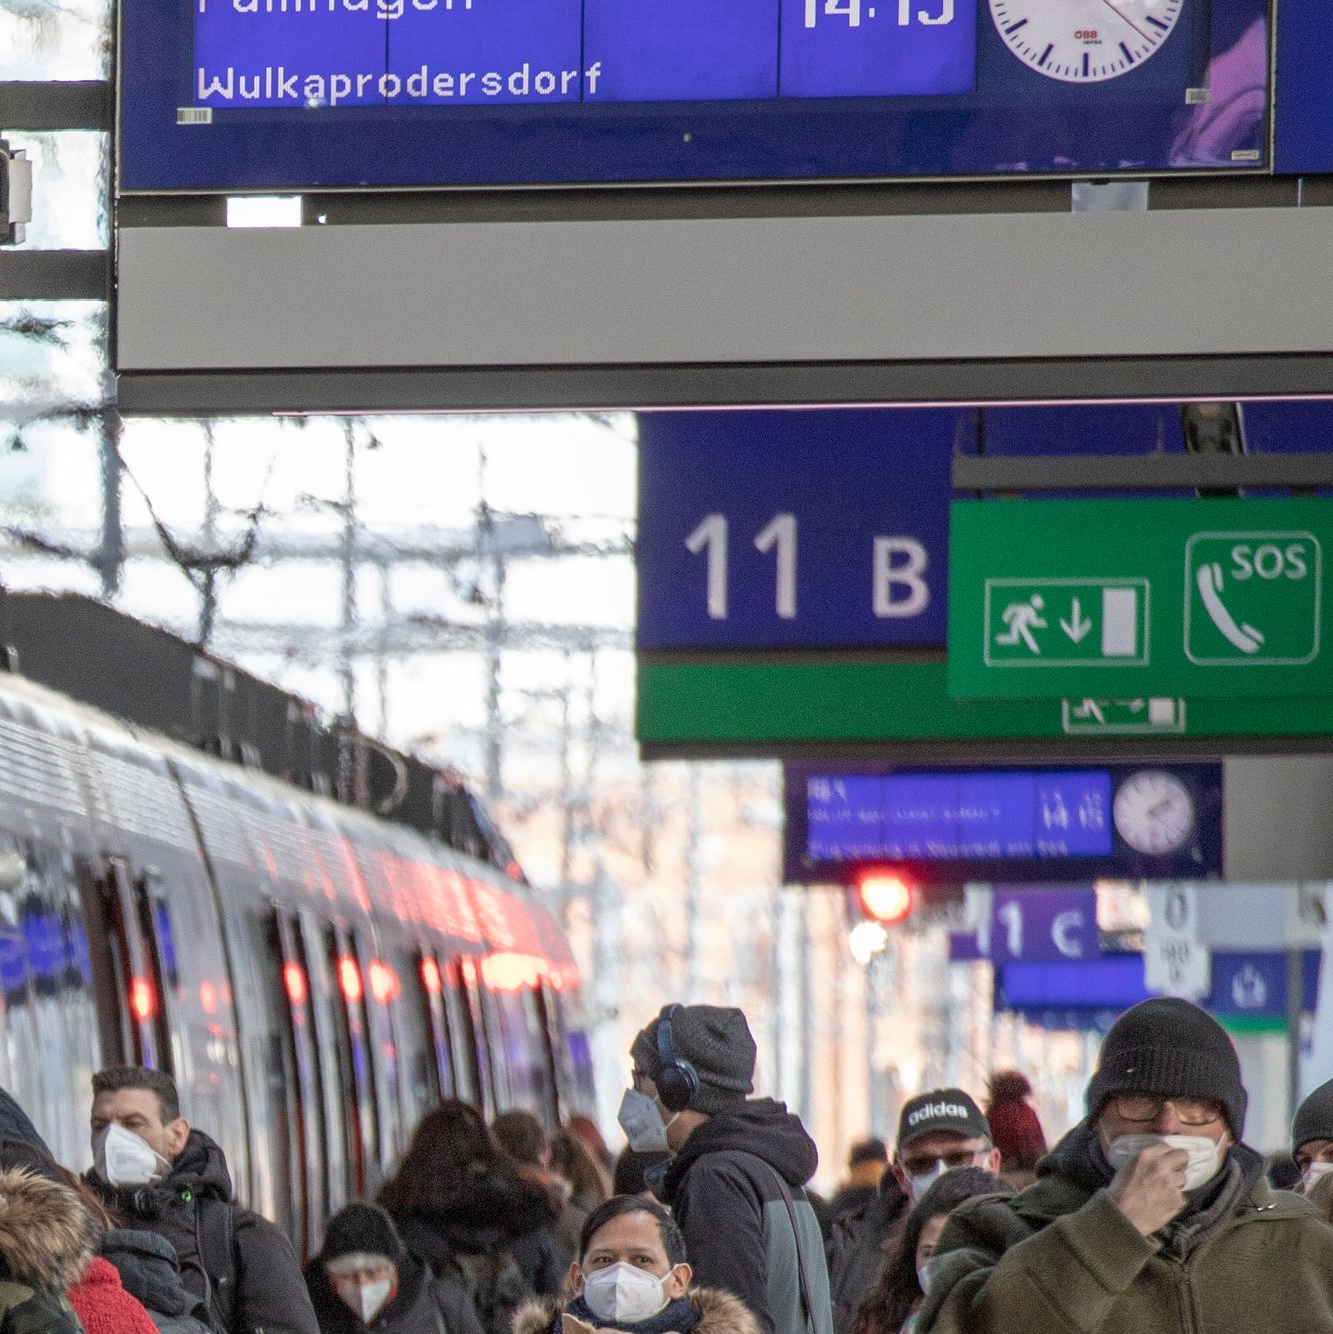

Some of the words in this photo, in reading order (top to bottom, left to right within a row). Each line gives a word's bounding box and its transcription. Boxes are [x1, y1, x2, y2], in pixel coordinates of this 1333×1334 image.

[198, 62, 602, 106] Wulkaprodersdorf
[685, 513, 798, 620] 11
[872, 535, 931, 618] B
[1231, 544, 1308, 580] SOS
[908, 1101, 969, 1126] adidas
